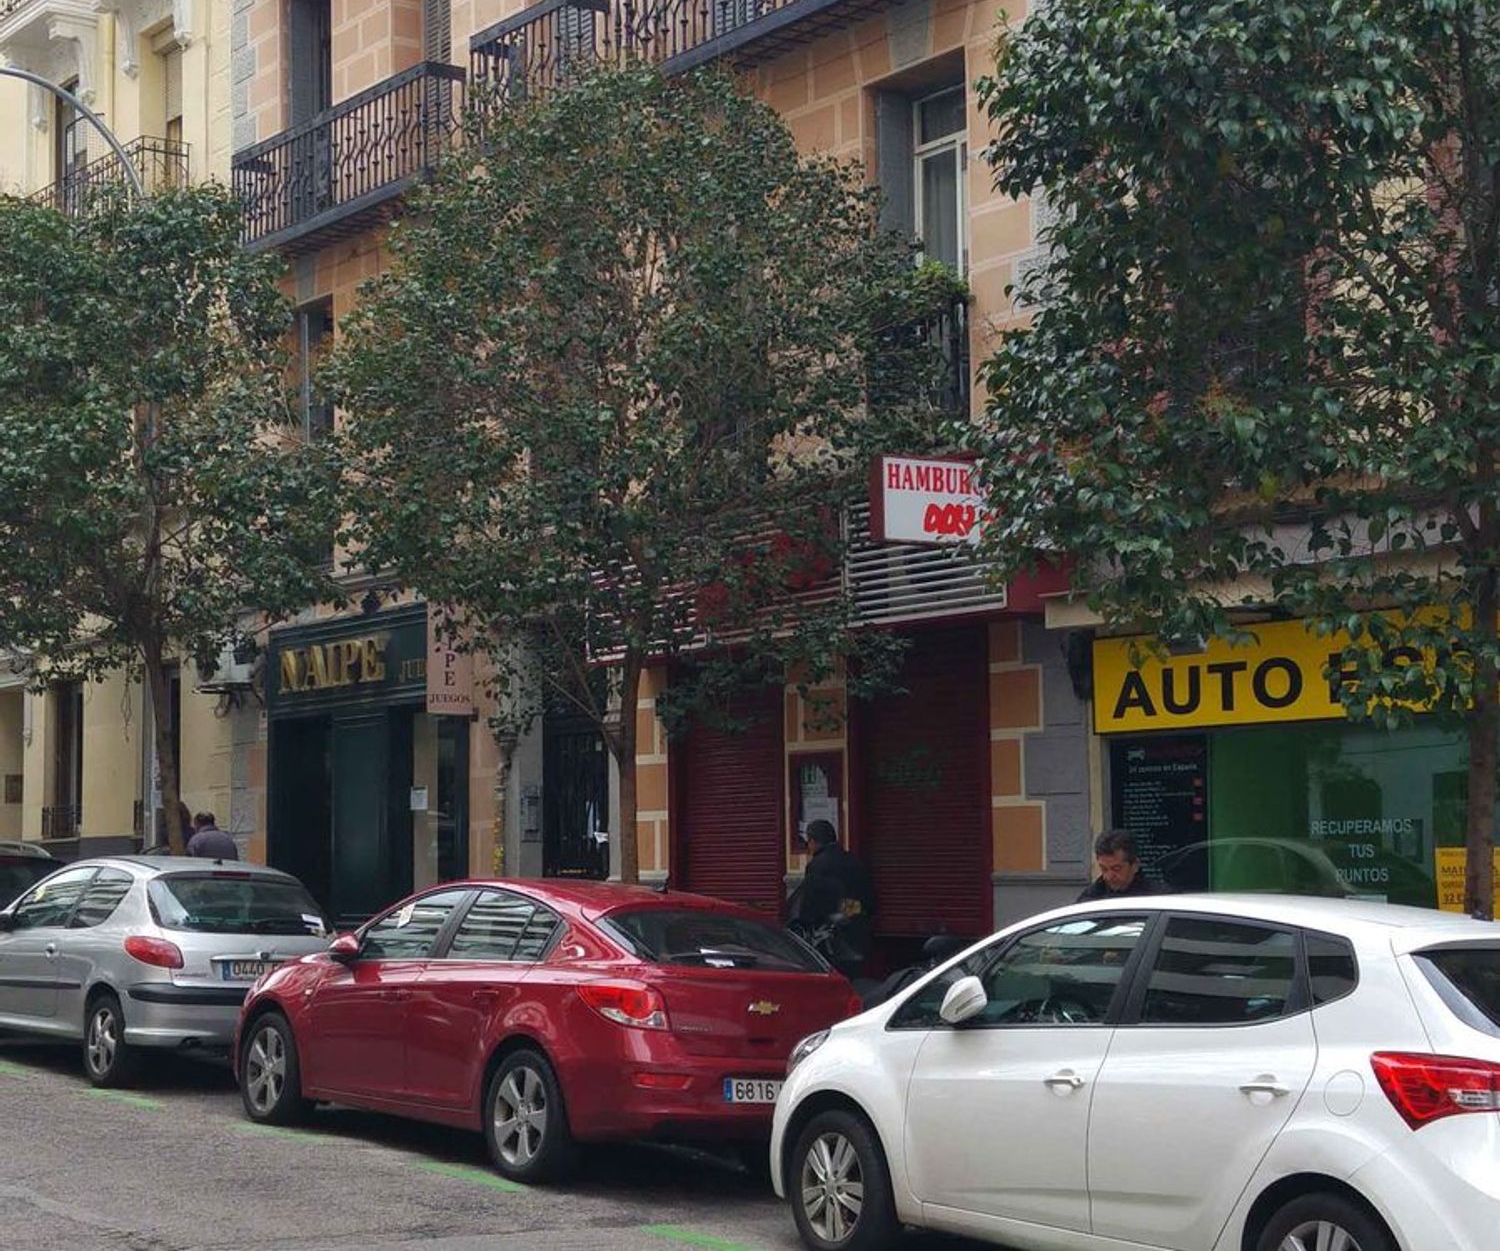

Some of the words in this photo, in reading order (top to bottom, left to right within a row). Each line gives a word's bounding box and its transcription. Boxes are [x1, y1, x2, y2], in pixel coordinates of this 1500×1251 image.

[887, 462, 994, 496] HAMBUR
[279, 637, 386, 693] NAIPE
[1112, 656, 1303, 719] AUTO
[429, 693, 470, 704] JUEGOS
[1311, 819, 1412, 835] RECUPERAMOS
[1349, 844, 1375, 858] TUS
[1336, 868, 1389, 883] PUNTOS
[232, 961, 265, 976] 0440
[735, 1082, 775, 1100] 6816
